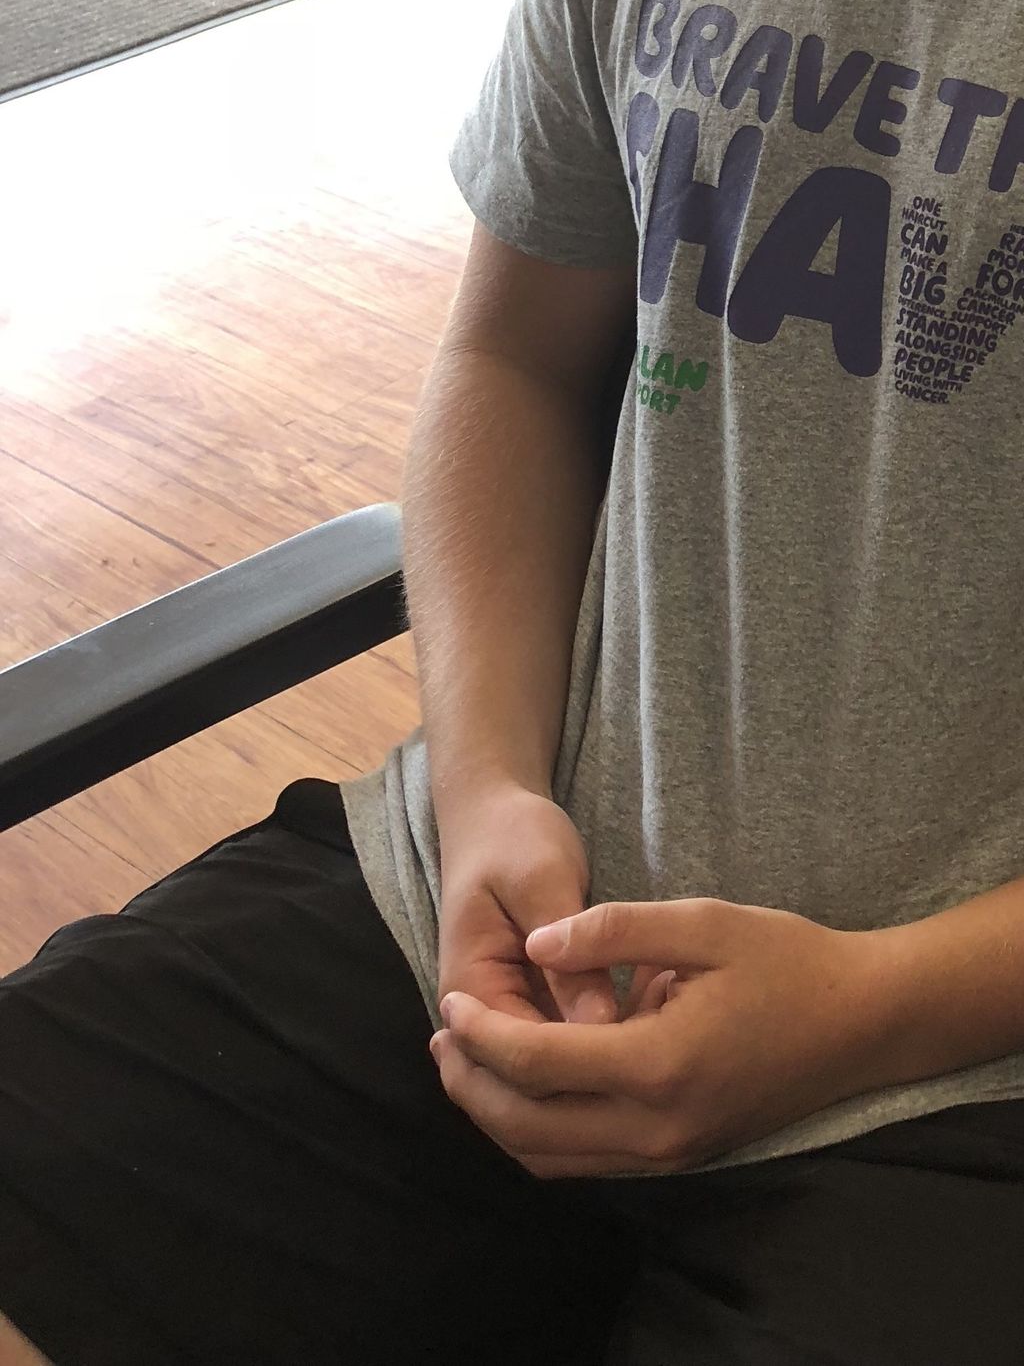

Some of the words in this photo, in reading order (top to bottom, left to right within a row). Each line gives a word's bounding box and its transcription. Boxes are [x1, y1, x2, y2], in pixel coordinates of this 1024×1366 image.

[902, 207, 948, 232] HAIRCUT
[912, 196, 943, 217] ONE
[901, 222, 949, 256] CAN
[900, 247, 936, 271] MAKE
[935, 261, 948, 276] A
[899, 264, 948, 306] BIG
[957, 297, 1016, 326] CANCER
[896, 307, 999, 353] STANDING
[895, 329, 988, 366] ALONGSIDE
[894, 347, 975, 383] PEOPLE
[895, 367, 931, 387] LIVING
[933, 379, 962, 393] WITH
